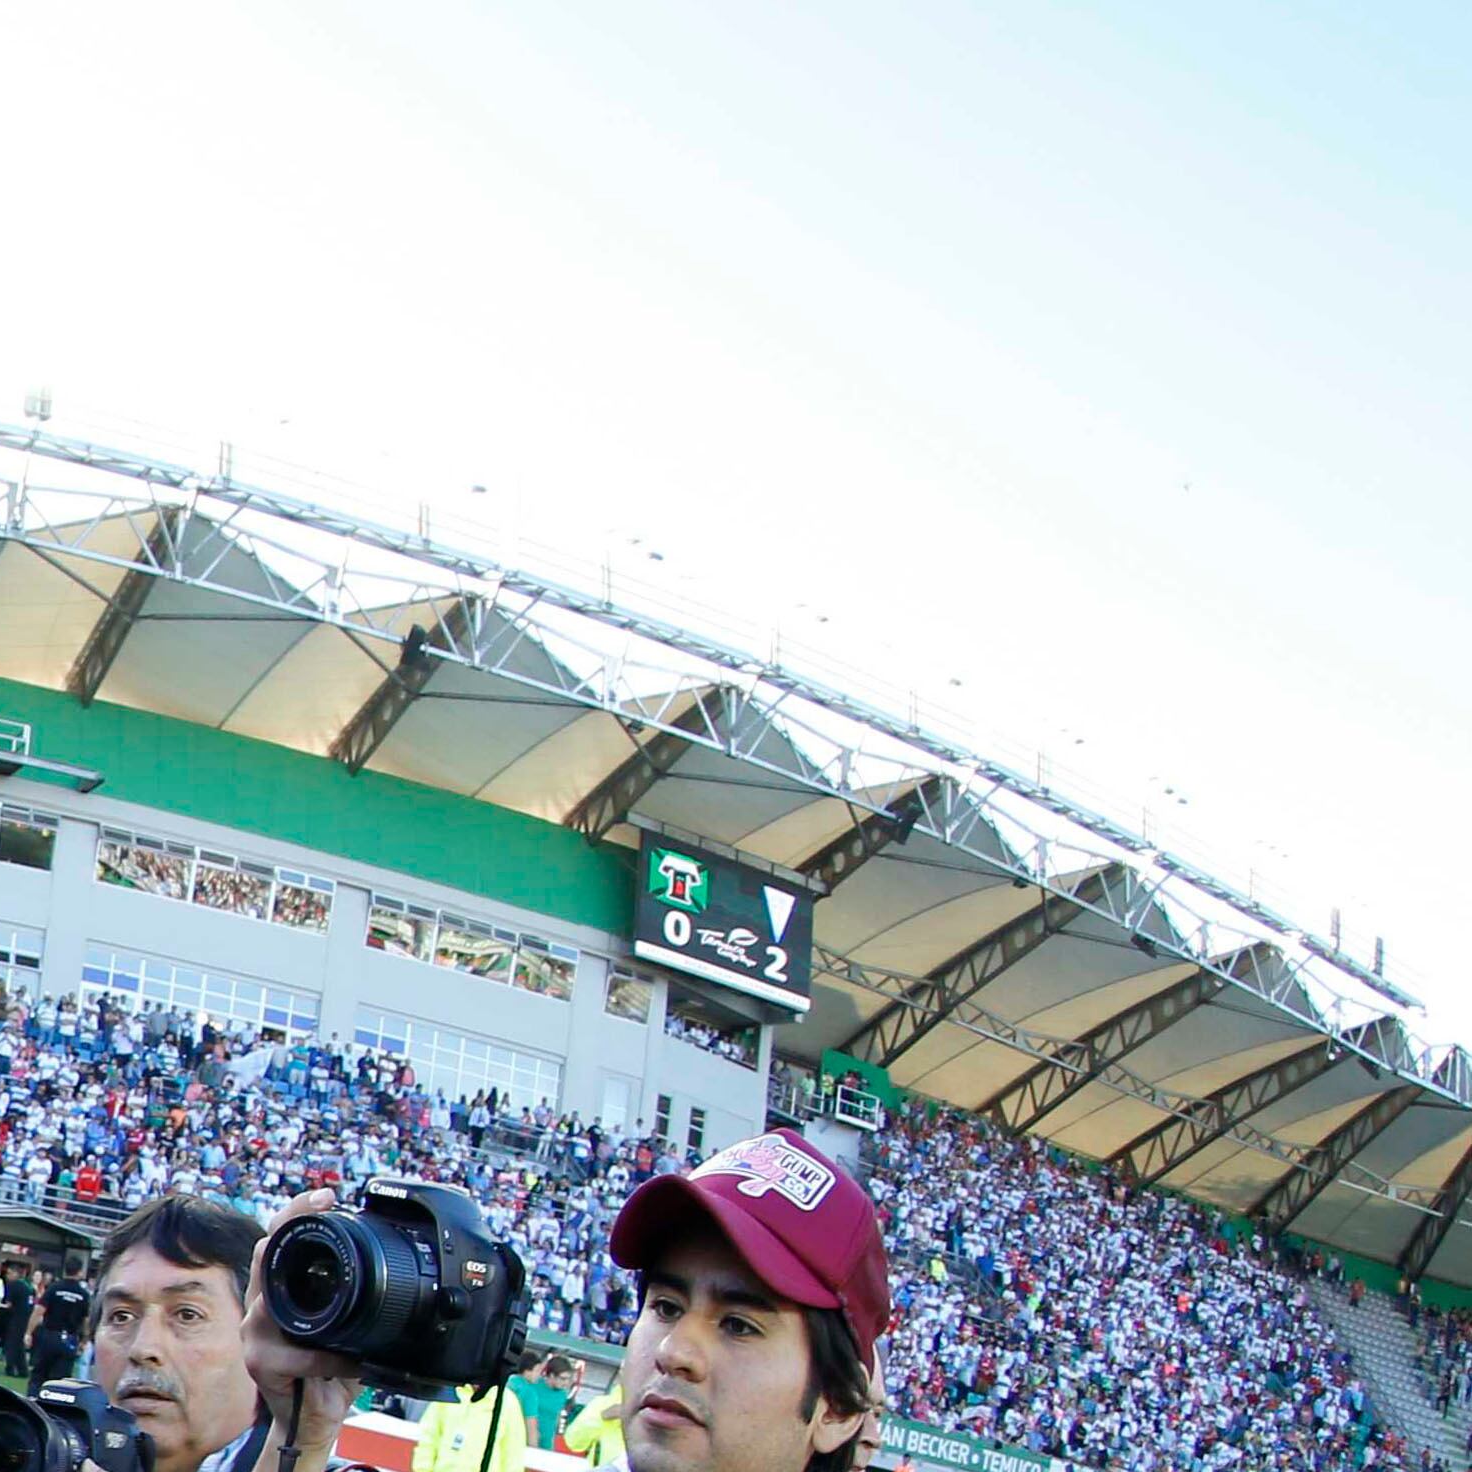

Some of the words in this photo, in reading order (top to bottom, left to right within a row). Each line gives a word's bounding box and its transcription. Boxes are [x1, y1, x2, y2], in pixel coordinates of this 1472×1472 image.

[663, 910, 691, 947] 0
[763, 945, 789, 983] 2
[780, 1153, 822, 1184] GUMP
[369, 1183, 408, 1199] Canon
[466, 1260, 487, 1273] EOS
[909, 1429, 970, 1465] BECKER
